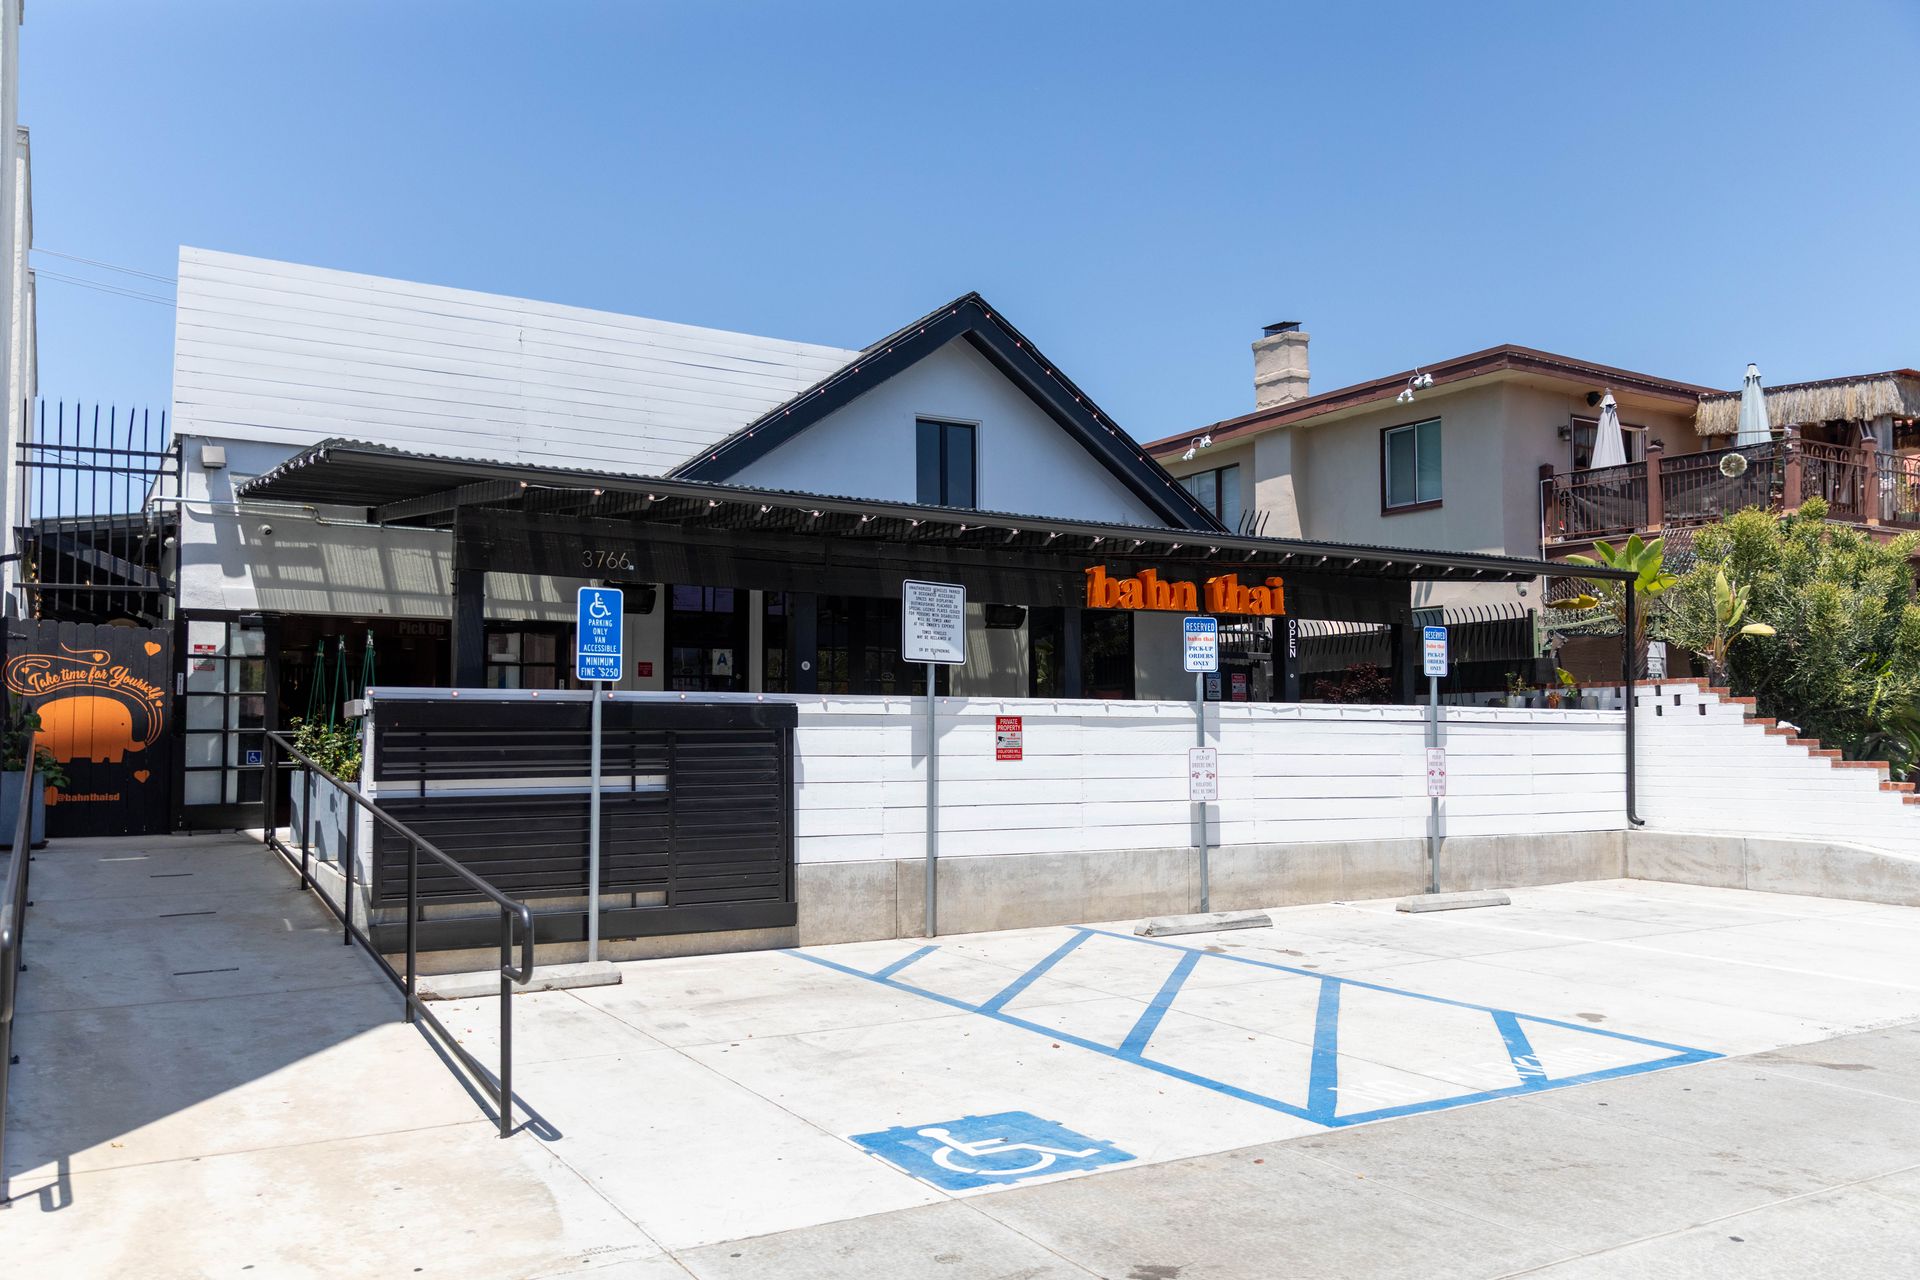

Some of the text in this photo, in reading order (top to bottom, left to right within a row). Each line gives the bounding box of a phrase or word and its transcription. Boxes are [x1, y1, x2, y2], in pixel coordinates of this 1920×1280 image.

[582, 550, 630, 569] 3766
[1085, 565, 1285, 615] bahn thai
[400, 622, 444, 637] Pick Up
[1186, 622, 1214, 631] RESERVED
[1426, 631, 1445, 640] RESERVED
[586, 657, 613, 666] MINIMUM
[717, 653, 728, 665] A
[581, 667, 618, 677] FINE $250
[28, 672, 60, 692] Take
[61, 669, 87, 681] time
[88, 666, 108, 683] for
[108, 666, 165, 699] Yourself
[58, 793, 120, 801] @bahnthaisd
